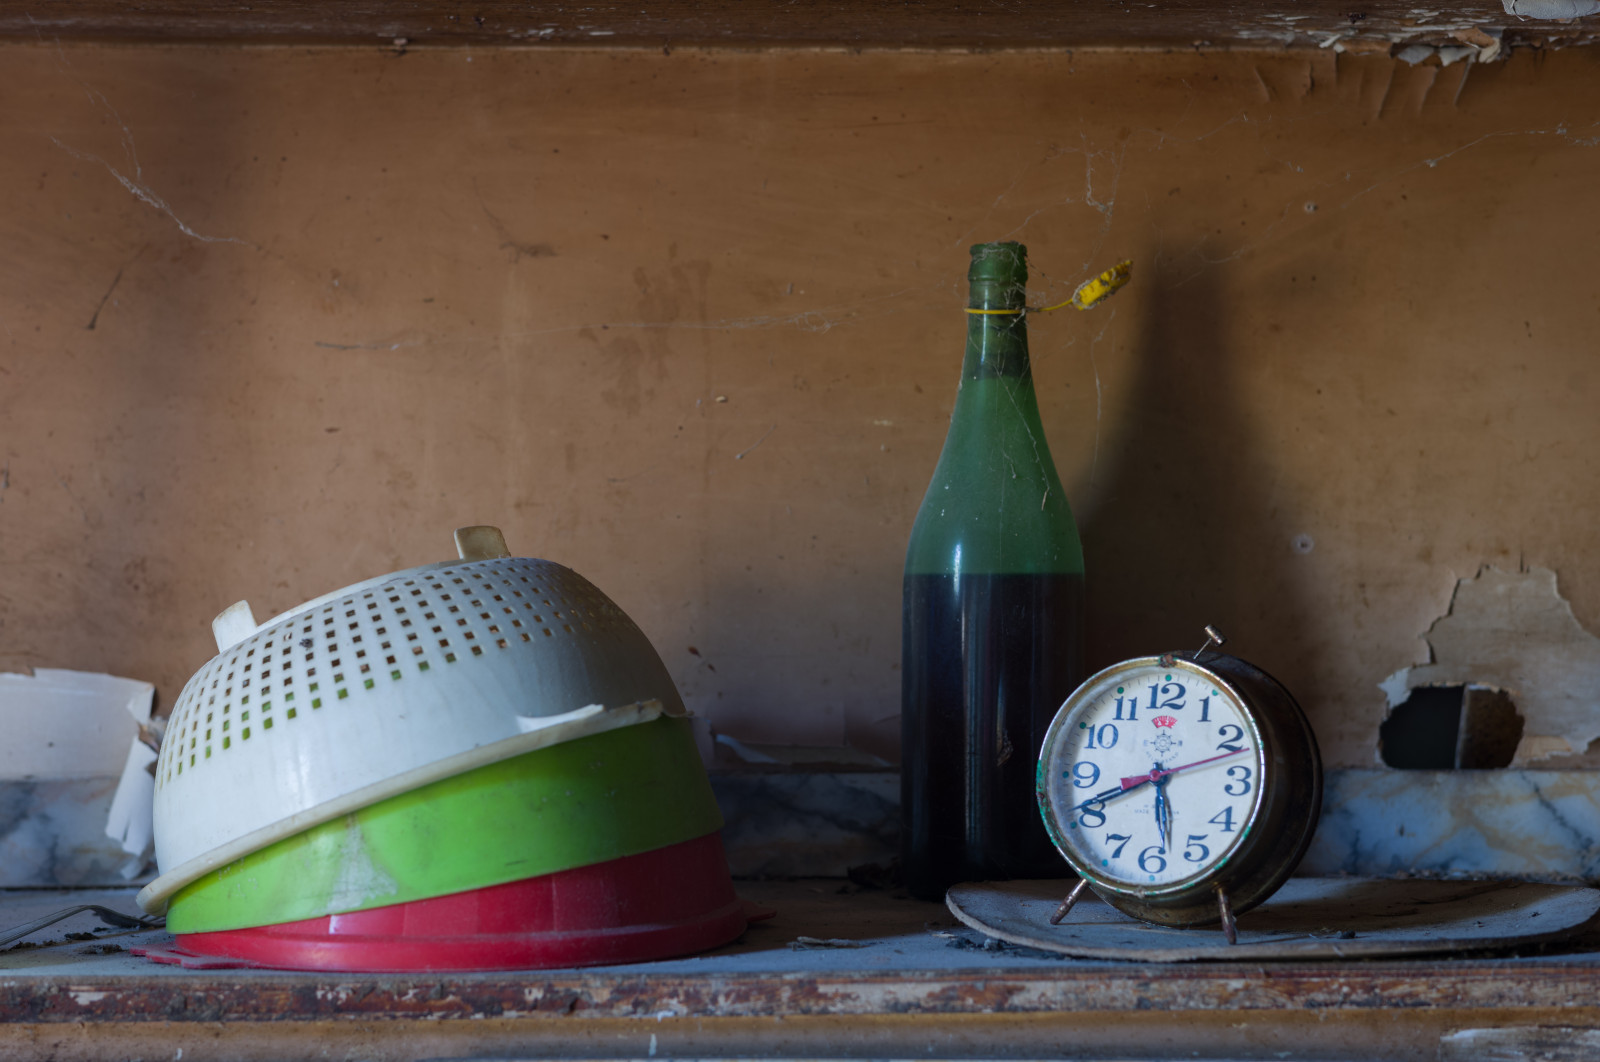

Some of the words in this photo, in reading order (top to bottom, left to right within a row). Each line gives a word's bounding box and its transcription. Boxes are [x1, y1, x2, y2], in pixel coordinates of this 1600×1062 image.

[1112, 696, 1138, 721] 11
[1146, 682, 1186, 710] 12
[1197, 696, 1212, 722] 1
[1083, 723, 1119, 749] 10
[1216, 724, 1244, 751] 2
[1072, 761, 1100, 788] 9
[1224, 765, 1252, 796] 3
[1078, 800, 1106, 828] 8
[1208, 805, 1237, 832] 4
[1105, 833, 1132, 859] 7
[1183, 834, 1210, 862] 5
[1137, 846, 1167, 874] 6
